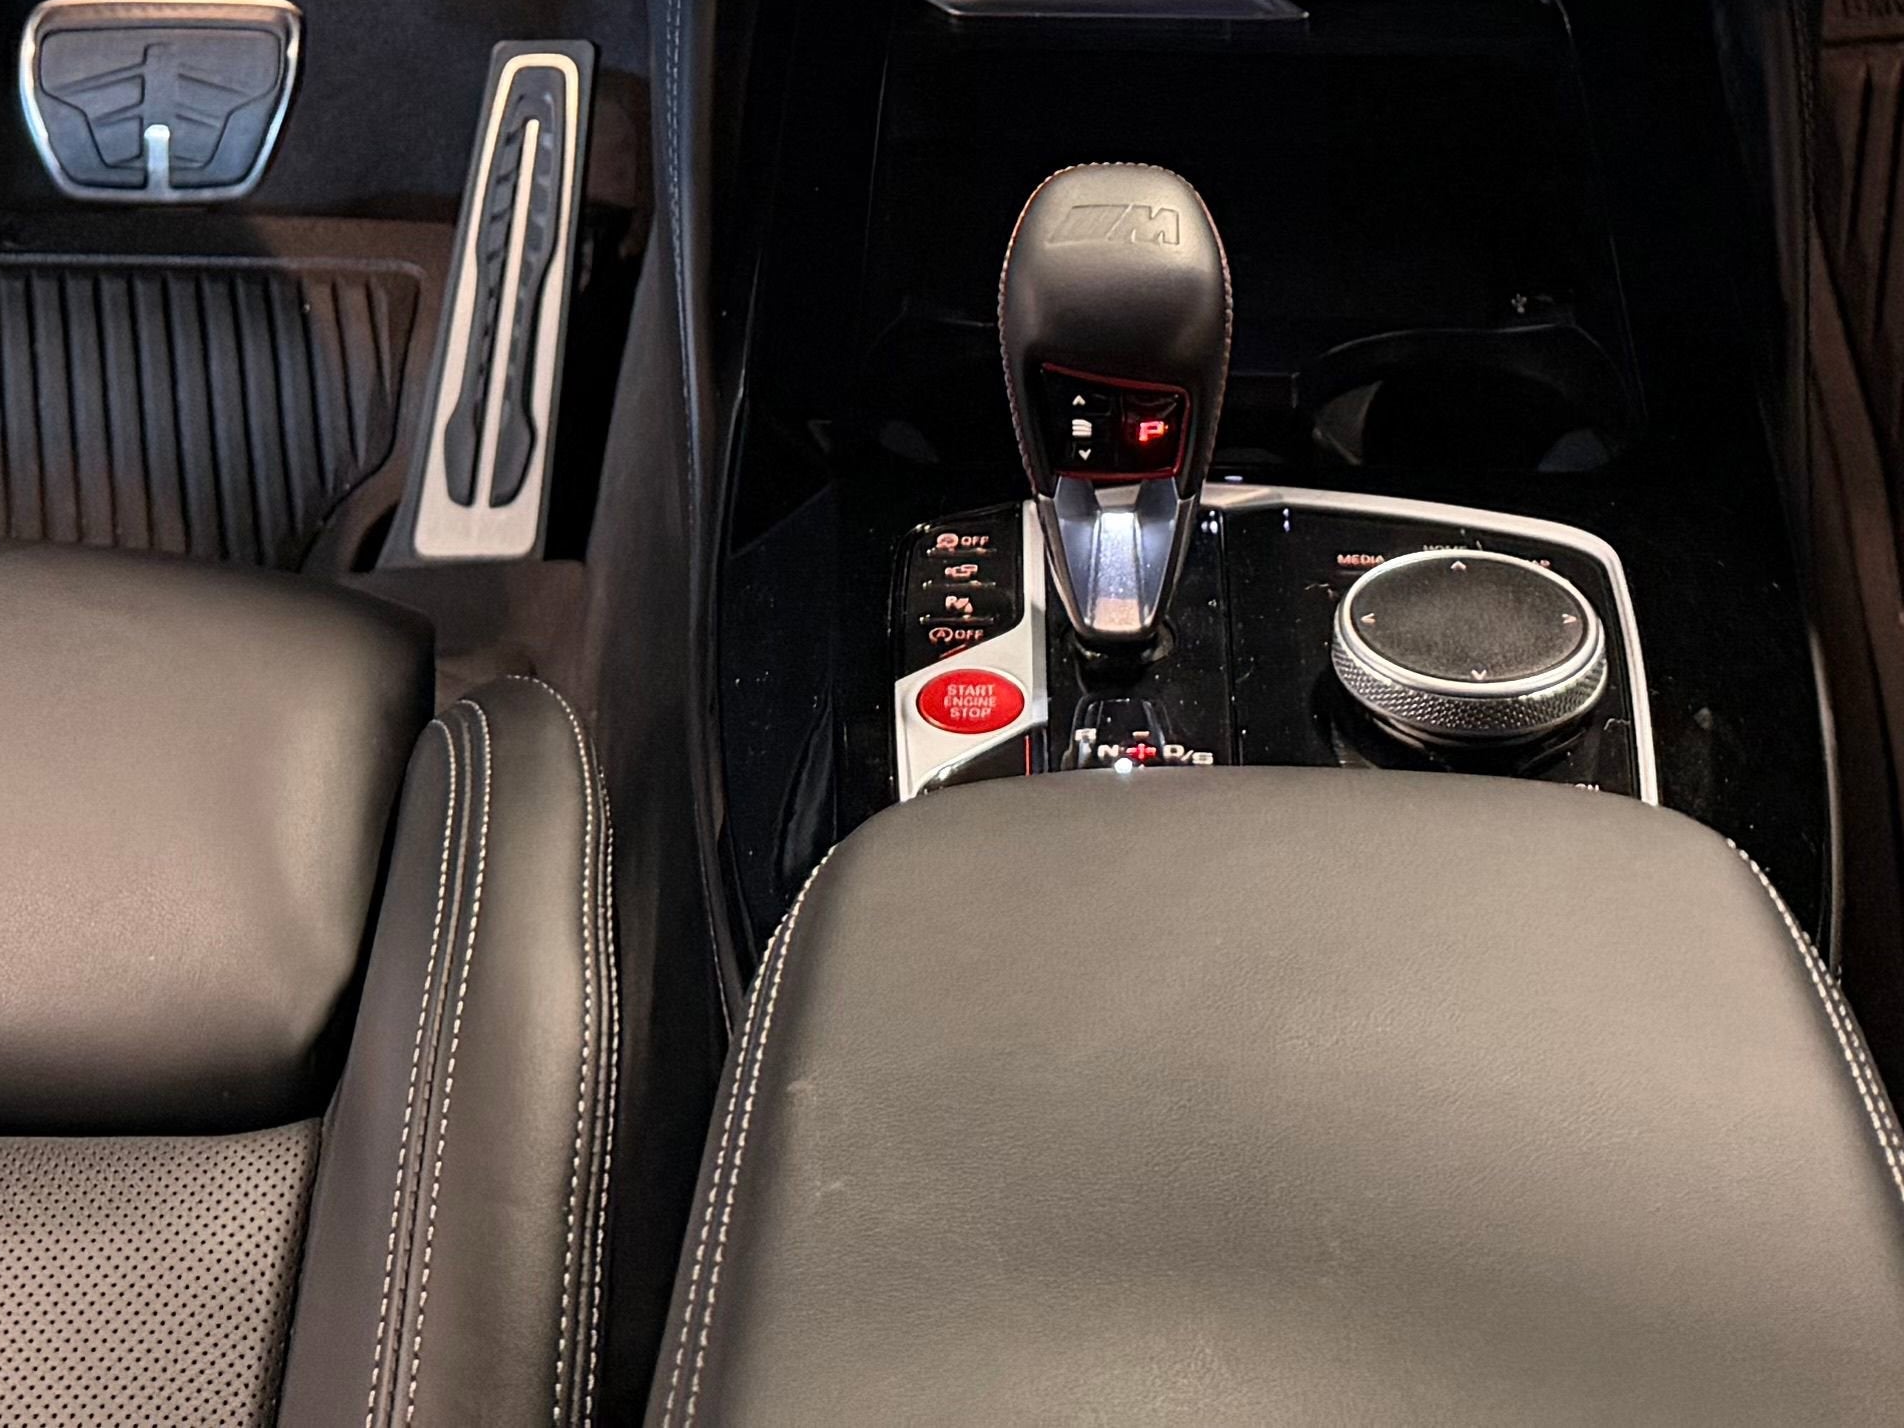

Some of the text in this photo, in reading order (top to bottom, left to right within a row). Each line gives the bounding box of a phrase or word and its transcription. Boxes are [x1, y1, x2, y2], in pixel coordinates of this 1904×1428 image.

[1139, 421, 1165, 442] P
[961, 535, 989, 546] OFF
[1337, 554, 1385, 566] MEDIA
[955, 629, 984, 640] OFF
[948, 684, 995, 695] START
[944, 696, 995, 708] ENGINE
[950, 707, 992, 719] STOP
[1097, 744, 1119, 757] N
